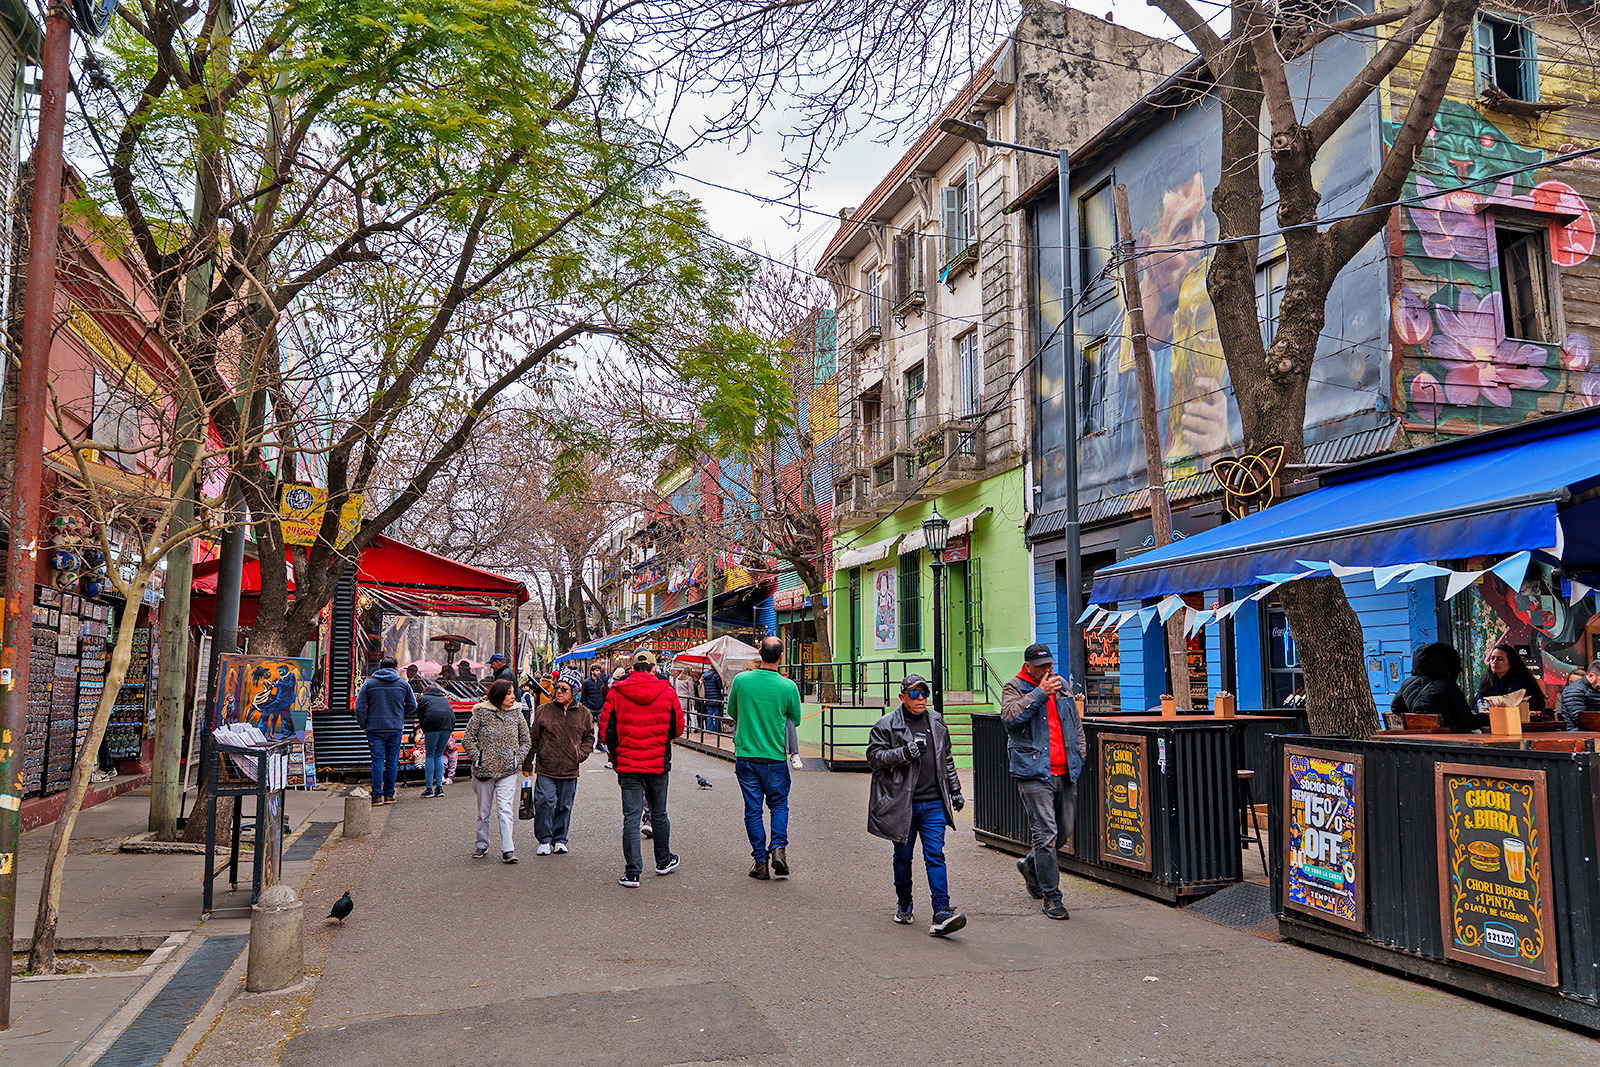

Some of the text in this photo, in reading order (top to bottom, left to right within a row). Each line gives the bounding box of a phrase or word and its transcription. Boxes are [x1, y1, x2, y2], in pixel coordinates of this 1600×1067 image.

[660, 628, 707, 638] LA VIEJA
[632, 640, 694, 650] ROTISERIA
[1113, 749, 1133, 764] CHORI
[1115, 762, 1137, 779] BIRRA
[1300, 779, 1346, 798] SOCIOS BOCA
[1465, 789, 1511, 811] CHORI
[1304, 795, 1344, 833] 15%
[1464, 809, 1520, 837] & BIRRA
[1304, 827, 1343, 865] OFF
[1311, 868, 1322, 876] TODA
[1328, 873, 1343, 881] CARTA
[1310, 890, 1336, 905] TEMPLE
[1466, 878, 1531, 901] CHORI BURGER
[1485, 894, 1516, 912] PINTA
[1470, 903, 1488, 915] LATA
[1489, 908, 1498, 917] DE
[1499, 910, 1530, 924] GASEOSA
